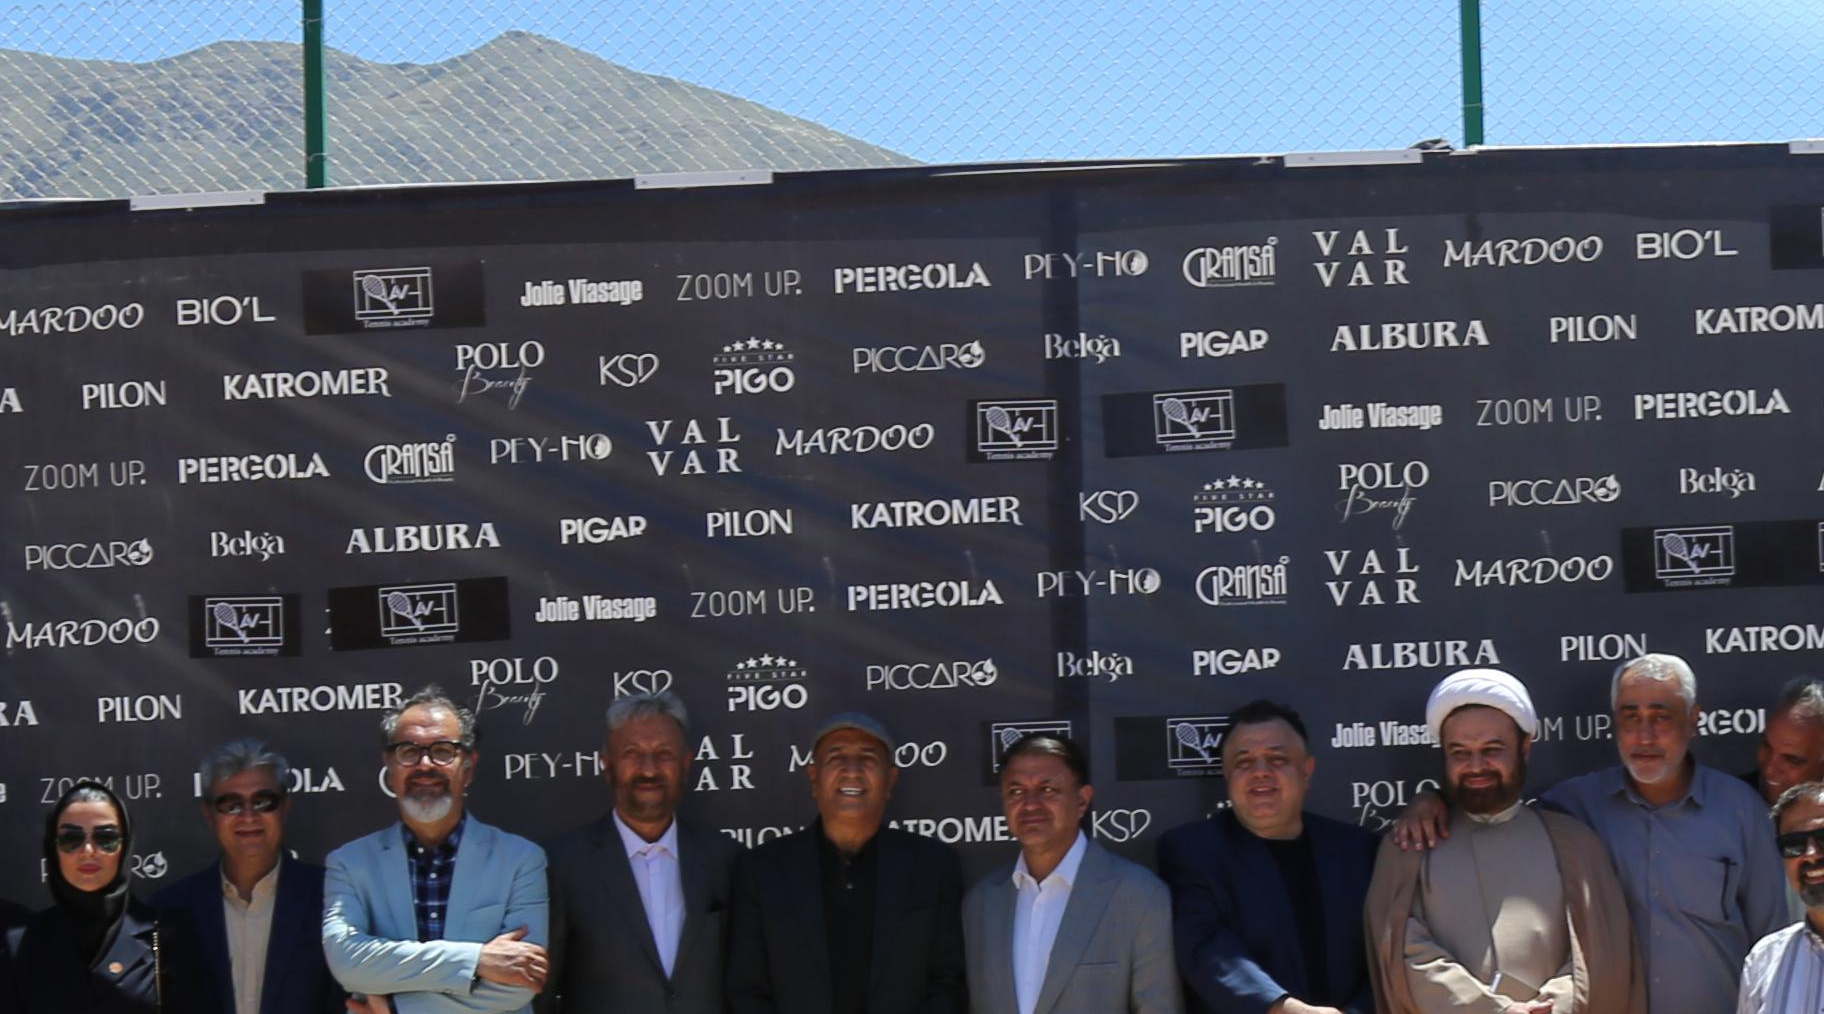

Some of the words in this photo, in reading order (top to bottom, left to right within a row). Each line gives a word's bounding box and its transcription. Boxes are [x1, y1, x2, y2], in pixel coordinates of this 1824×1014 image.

[1443, 235, 1604, 268] MARDOO
[1636, 229, 1739, 260] BIO'L
[520, 280, 566, 307] Jolie
[567, 278, 643, 306] Viasage
[676, 272, 753, 301] ZOOM
[764, 269, 803, 297] UP.
[834, 262, 992, 294] PERGOLA
[176, 295, 277, 326] BIO'L
[1180, 329, 1269, 358] PIGAR
[1330, 319, 1490, 352] ALBURA
[1550, 314, 1637, 343] PILON
[455, 340, 545, 372] POLO
[1044, 332, 1121, 364] Belga
[82, 380, 167, 410] PILON
[223, 367, 392, 401] KATROMER
[714, 366, 795, 395] PIGO
[1318, 403, 1364, 430] Jolie
[1366, 402, 1443, 430] Viasage
[1476, 397, 1553, 427] ZOOM
[1564, 395, 1603, 423] UP.
[1634, 388, 1791, 420] PERGOLA
[775, 423, 935, 456] MARDOO
[23, 462, 99, 492] ZOOM
[109, 460, 147, 487] UP.
[178, 452, 331, 484] PERGOLA
[1339, 460, 1430, 492] POLO
[1679, 466, 1756, 499] Belga
[706, 508, 793, 538] PILON
[851, 496, 1023, 529] KATROMER
[1194, 505, 1275, 534] PIGO
[210, 530, 285, 562] Belga
[345, 522, 501, 554] ALBURA
[560, 515, 647, 545] PIGAR
[1454, 555, 1614, 587] MARDOO
[535, 596, 580, 623] Jolie
[582, 594, 657, 622] Viasage
[690, 589, 767, 618] ZOOM
[777, 586, 816, 614] UP.
[847, 579, 1004, 611] PERGOLA
[5, 617, 160, 649] MARDOO
[1561, 634, 1646, 661] PILON
[1057, 650, 1134, 683] Belga
[1192, 647, 1281, 676] PIGAR
[1343, 639, 1500, 670] ALBURA
[470, 656, 559, 688] POLO
[97, 694, 182, 723] PILON
[238, 682, 404, 714] KATROMER
[727, 683, 808, 712] PIGO
[1331, 722, 1376, 748] Jolie
[1575, 713, 1613, 741] UP.
[694, 733, 754, 761] AL
[125, 773, 162, 800] UP.
[694, 764, 755, 792] AR
